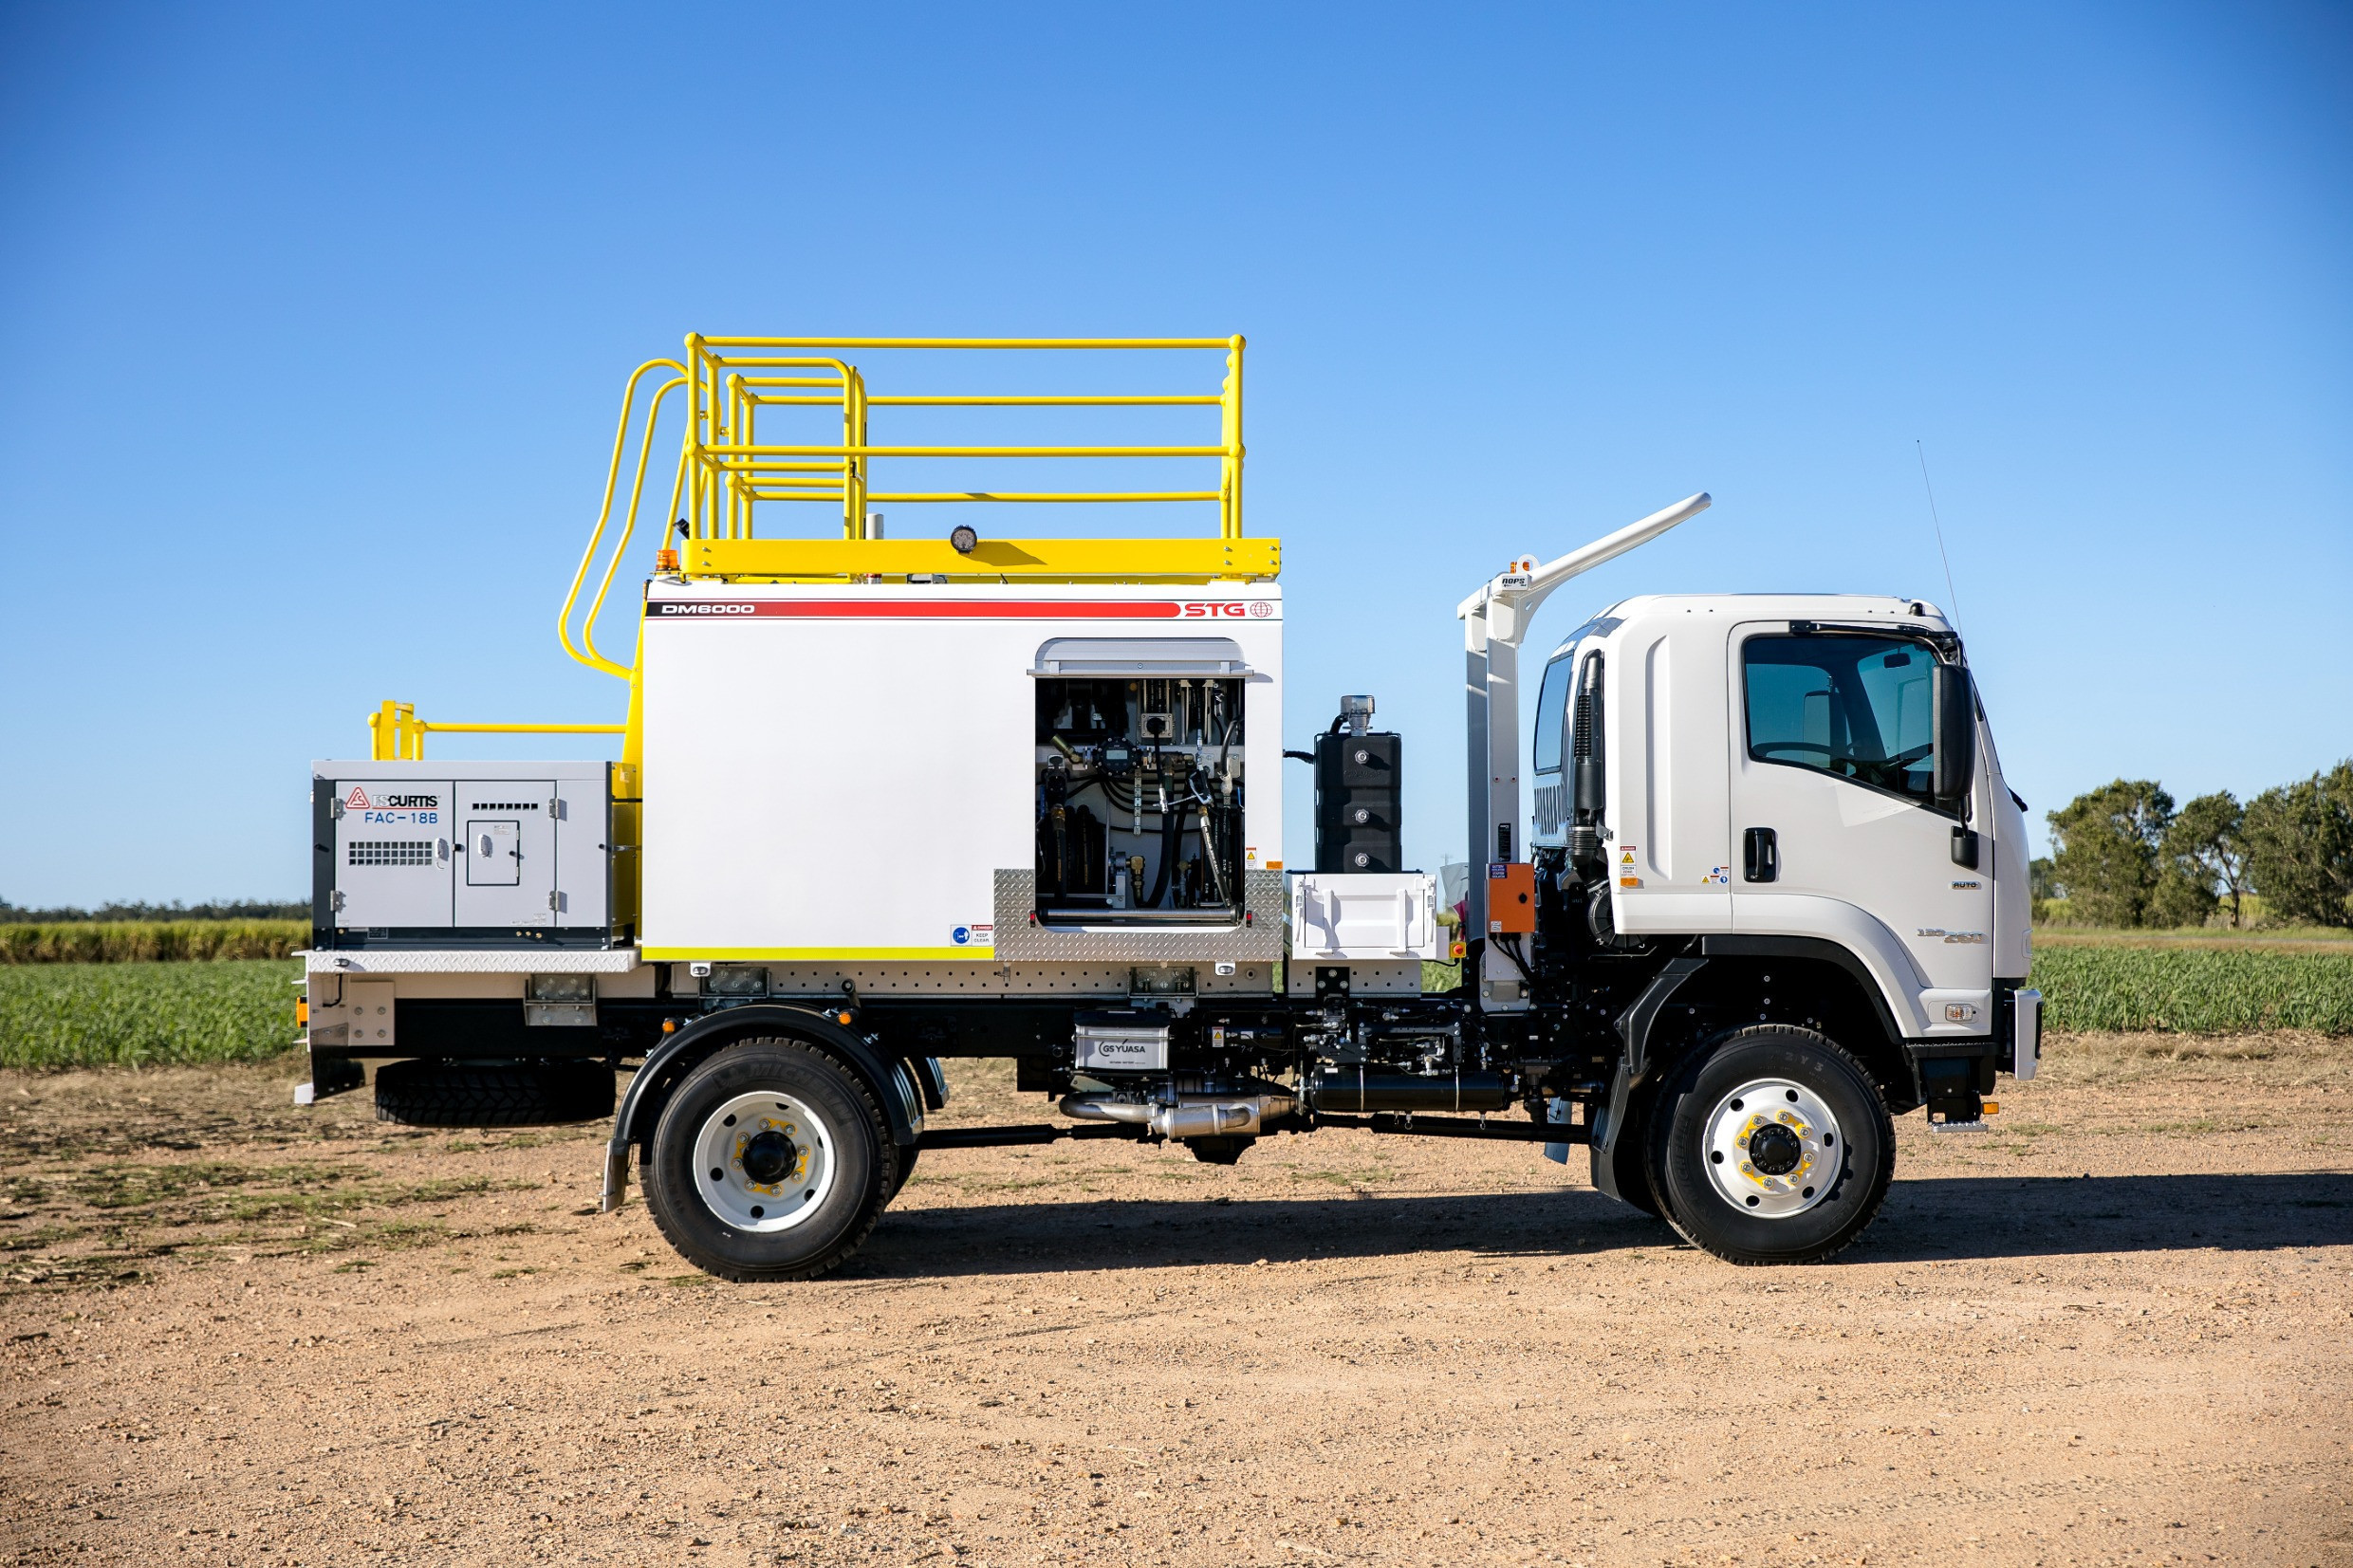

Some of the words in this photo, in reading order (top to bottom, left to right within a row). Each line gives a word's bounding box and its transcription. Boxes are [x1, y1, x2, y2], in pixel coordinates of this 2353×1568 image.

[661, 604, 755, 614] DM6000
[1185, 602, 1245, 617] STG
[365, 812, 437, 823] FAC-18B
[1102, 1044, 1115, 1053] GS
[1115, 1039, 1146, 1053] YUASA
